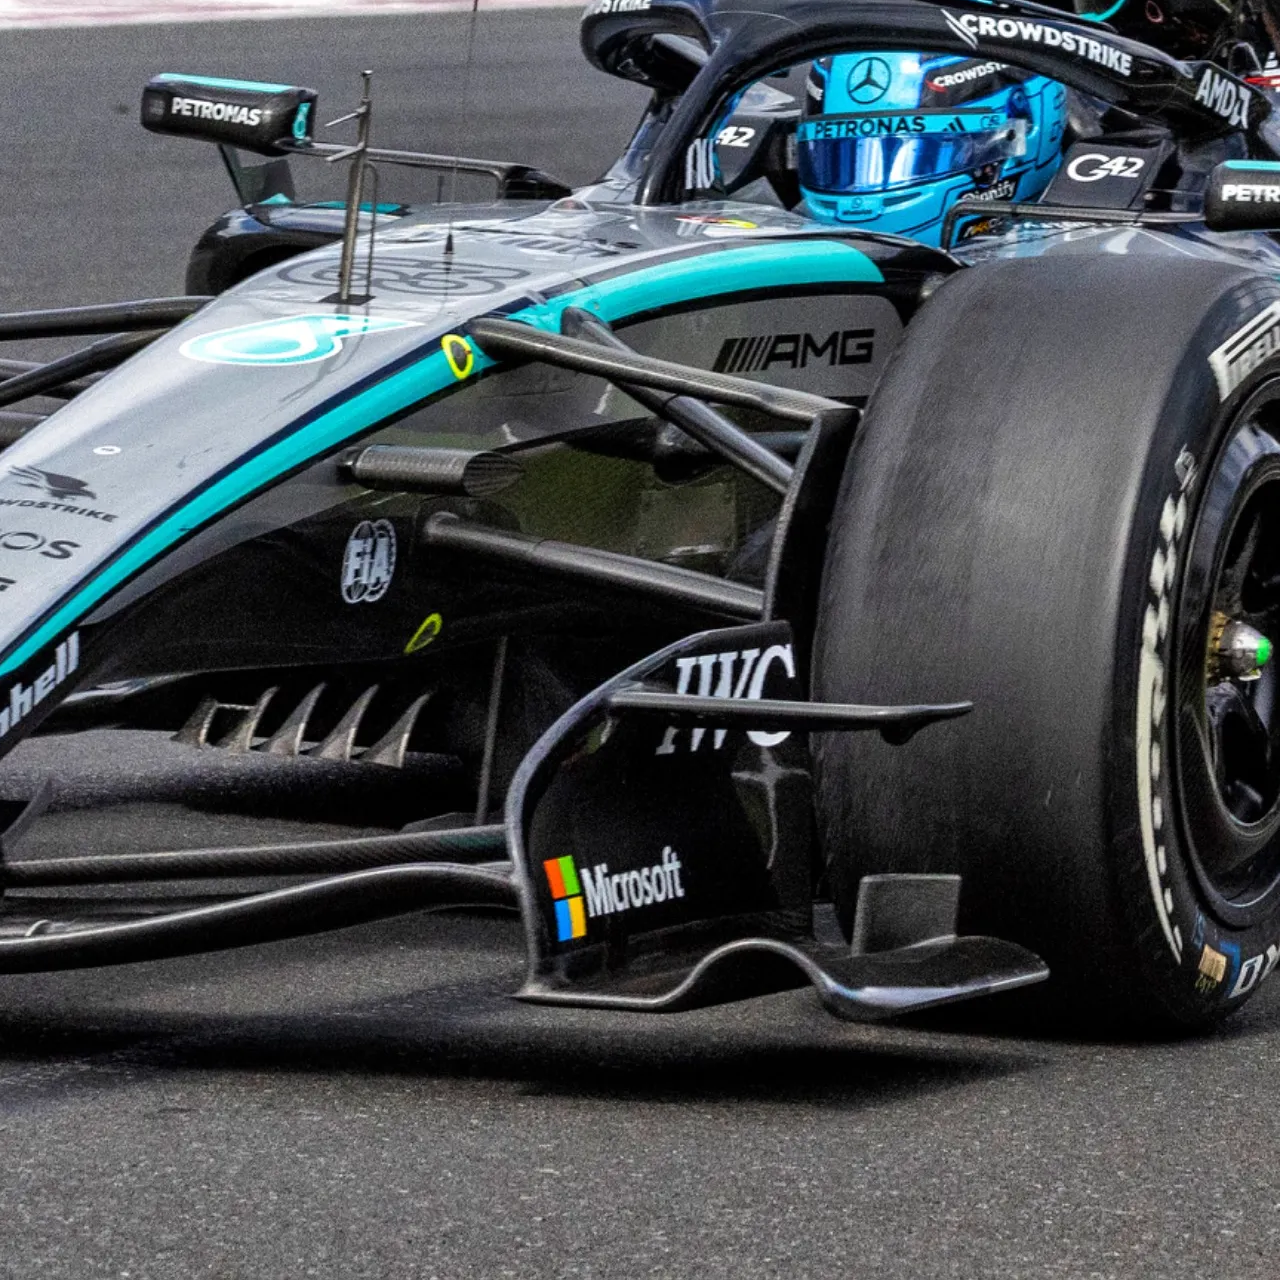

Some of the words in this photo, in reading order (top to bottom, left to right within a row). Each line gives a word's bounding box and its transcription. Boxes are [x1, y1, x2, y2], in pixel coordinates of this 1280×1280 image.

[957, 13, 1133, 77] CROWDSTRIKE
[171, 96, 262, 126] PETRONAS
[815, 116, 926, 138] PETRONAS
[715, 126, 756, 148] 42
[1066, 152, 1146, 183] G42
[761, 327, 874, 370] AMG
[654, 643, 796, 756] IWC
[581, 845, 685, 918] Microsoft
